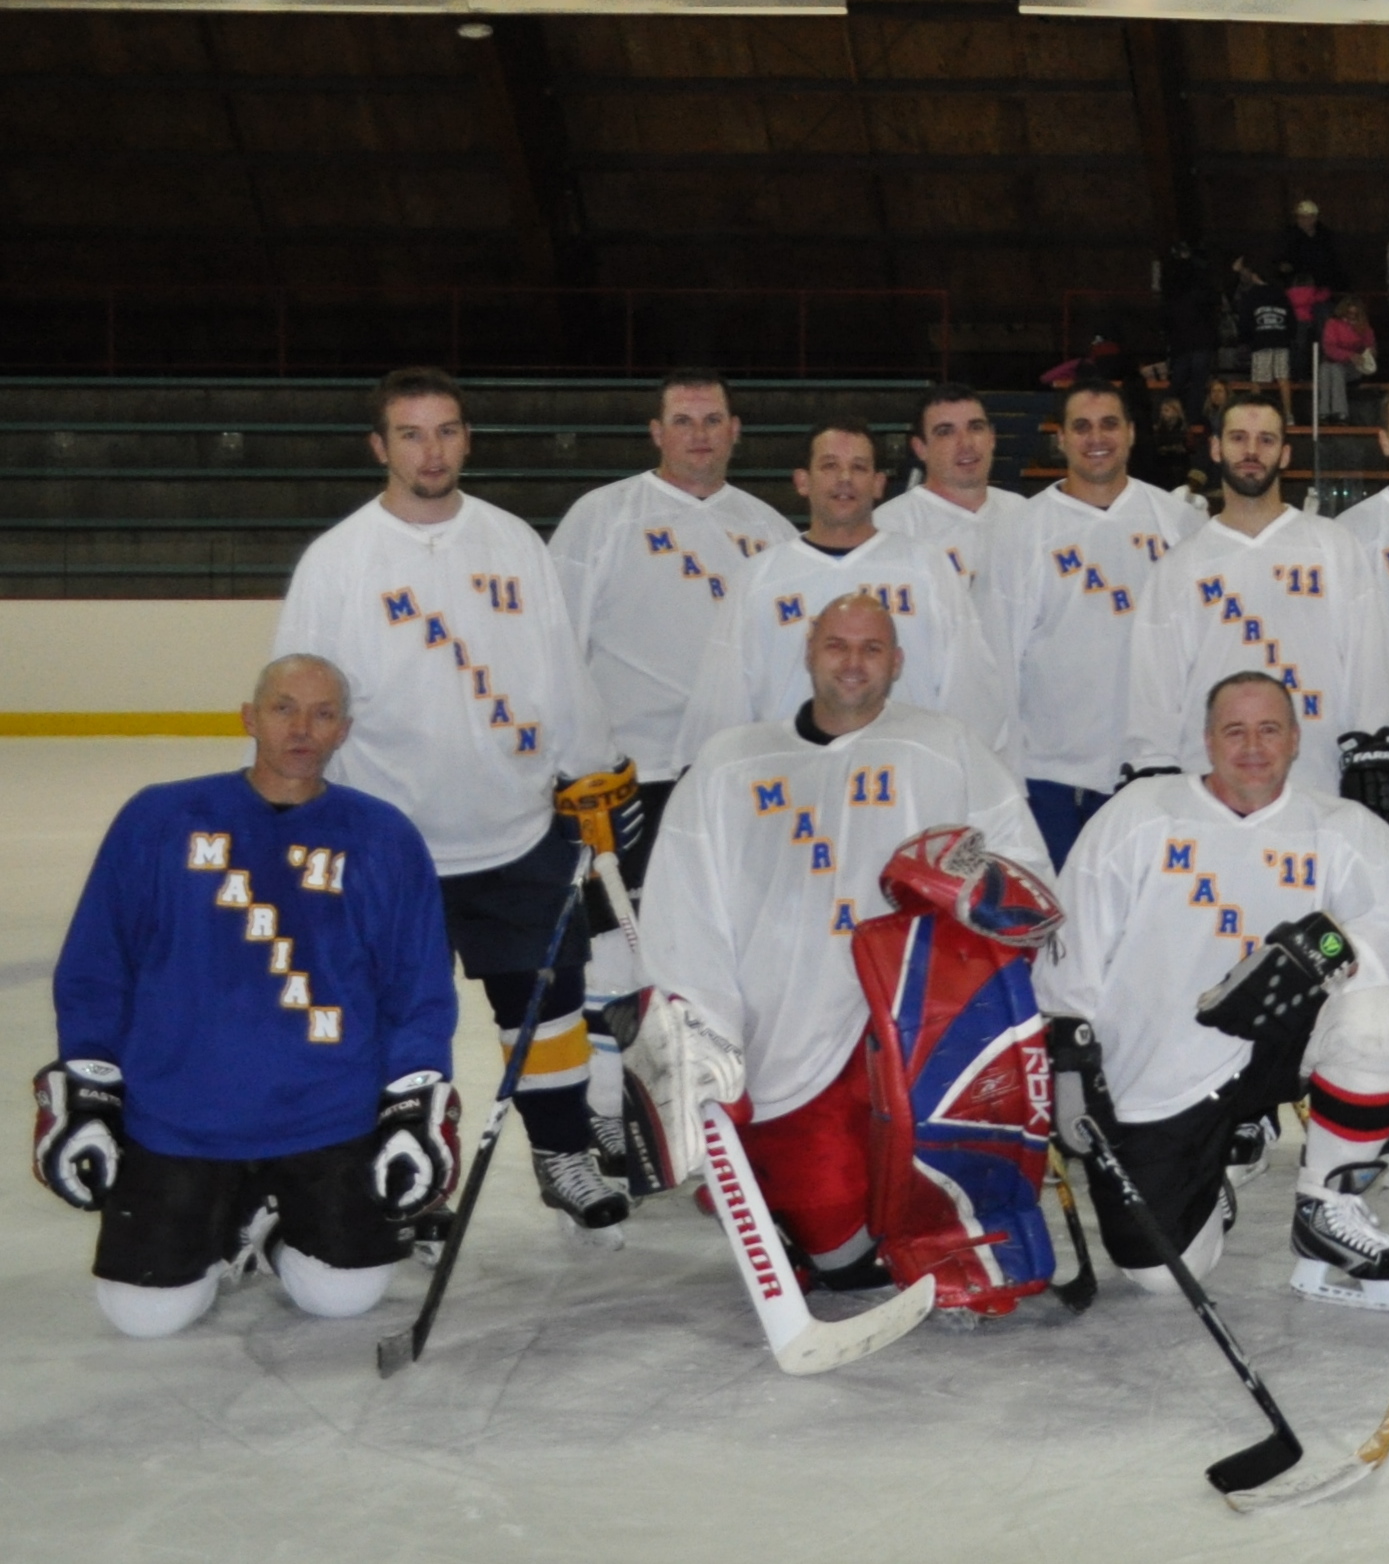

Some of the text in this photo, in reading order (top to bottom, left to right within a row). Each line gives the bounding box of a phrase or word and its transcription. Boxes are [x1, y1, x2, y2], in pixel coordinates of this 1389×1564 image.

[645, 527, 729, 601] MAR
[1052, 545, 1134, 615] MAR
[1273, 566, 1323, 598] '11
[470, 574, 524, 613] '11
[1198, 576, 1322, 719] MARIAN
[287, 844, 346, 894] '11
[1263, 849, 1318, 891] '11
[188, 831, 343, 1043] MARIAN
[78, 1087, 123, 1107] EASTO
